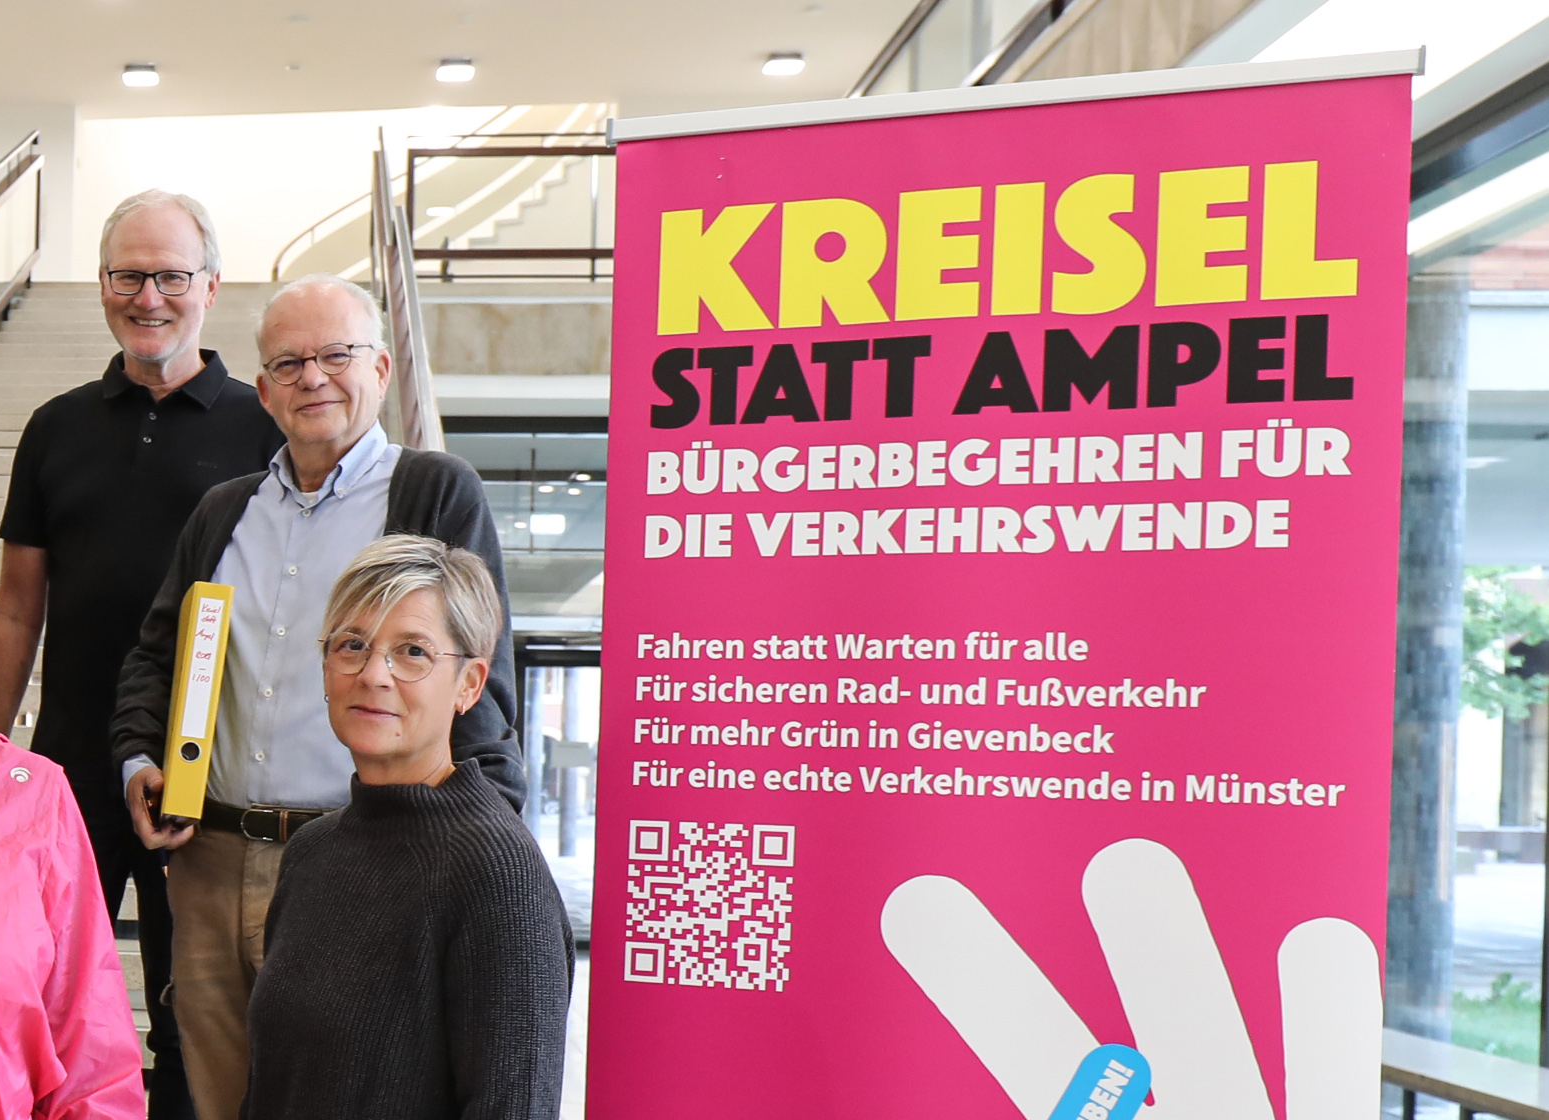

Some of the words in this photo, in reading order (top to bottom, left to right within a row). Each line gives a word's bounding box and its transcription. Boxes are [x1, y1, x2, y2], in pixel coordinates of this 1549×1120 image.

[656, 160, 1359, 336] KREISEL
[650, 335, 932, 430] STATT
[953, 314, 1354, 415] AMPEL
[646, 431, 1204, 495] BÜRGERBEGEHREN
[1219, 418, 1352, 478] FÜR
[644, 513, 733, 559] DIE
[745, 499, 1290, 557] VERKEHRSWENDE
[637, 632, 745, 660] Fahren
[752, 634, 828, 660] statt
[834, 633, 956, 660] Warten
[964, 631, 1019, 661] für
[1023, 631, 1089, 661] alle
[635, 674, 688, 702] Für
[691, 674, 828, 704] sicheren
[837, 676, 912, 704] Rad-
[920, 676, 987, 706] und
[996, 677, 1208, 708] Fußverkehr
[634, 717, 686, 744] Für
[690, 718, 776, 747] mehr
[780, 719, 860, 748] Grün
[868, 719, 899, 749] in
[907, 720, 1115, 754] Gievenbeck
[632, 759, 685, 787] Für
[688, 760, 756, 790] eine
[763, 763, 853, 793] echte
[858, 765, 1132, 801] Verkehrswende
[1141, 771, 1175, 802] in
[1185, 773, 1346, 807] Münster
